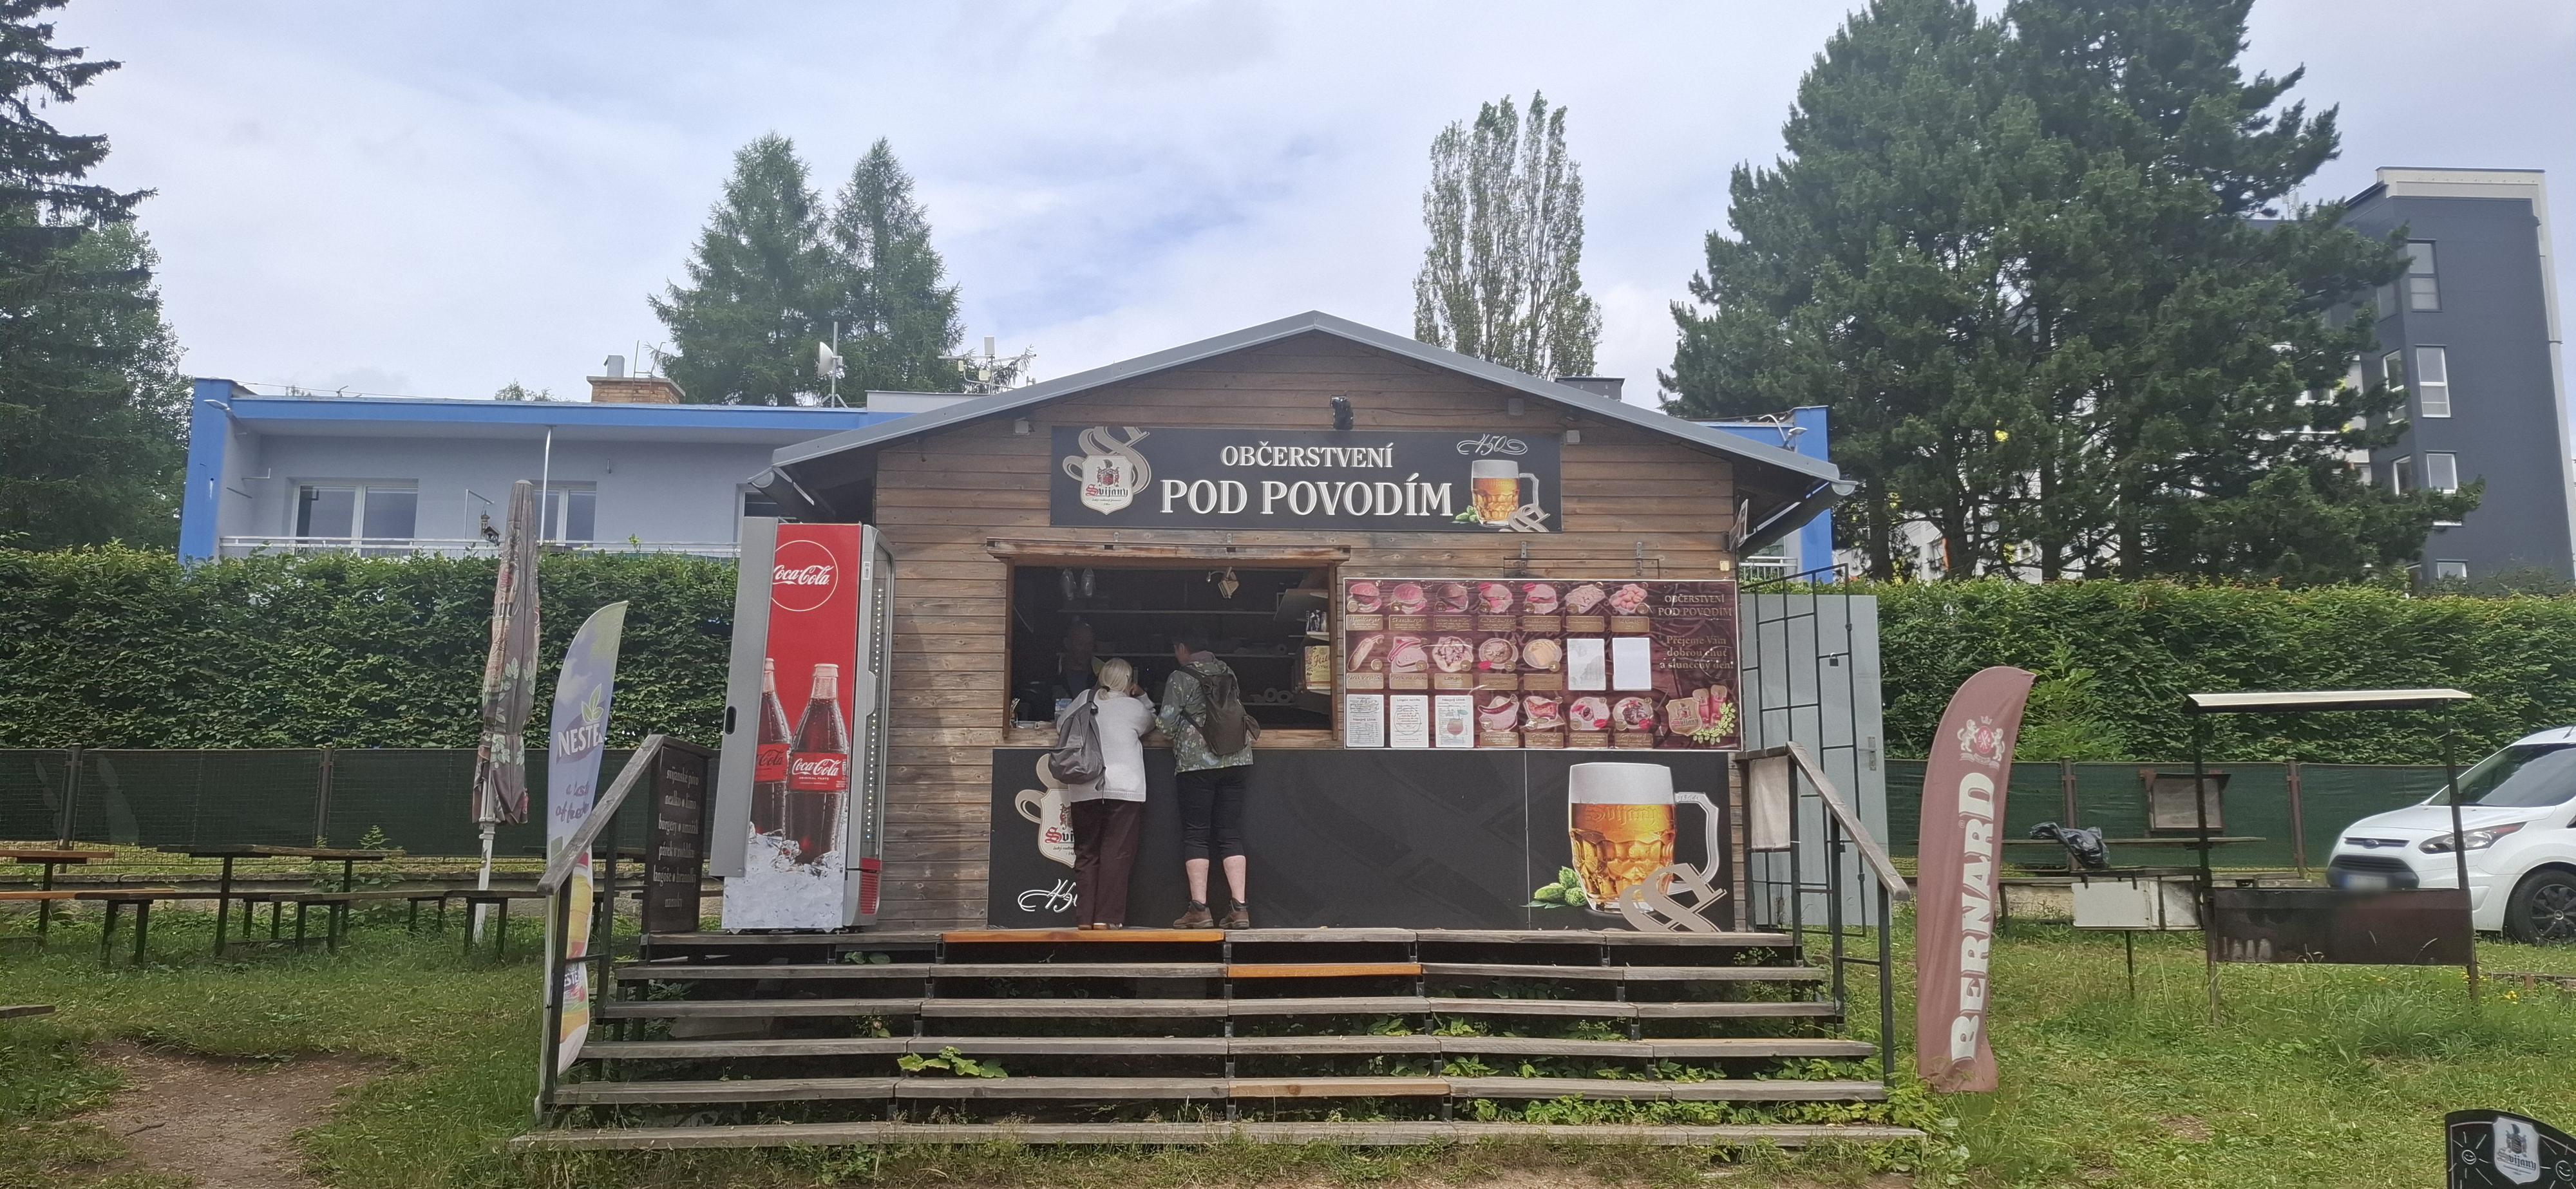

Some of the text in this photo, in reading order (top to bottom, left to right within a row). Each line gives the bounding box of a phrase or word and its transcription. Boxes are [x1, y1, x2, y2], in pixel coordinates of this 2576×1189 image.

[1221, 441, 1394, 468] OBČERSTVENÍ
[1086, 484, 1128, 497] Svijany
[1160, 473, 1454, 516] POD POVODÍM
[1664, 594, 1725, 603] OBČERSTVENÍ
[1658, 606, 1732, 617] POD POVODÍM
[1667, 646, 1702, 657] dobrou
[791, 758, 841, 776] Coca-Cola
[1951, 772, 1994, 1063] BERNARD
[2497, 1147, 2536, 1170] Svijany
